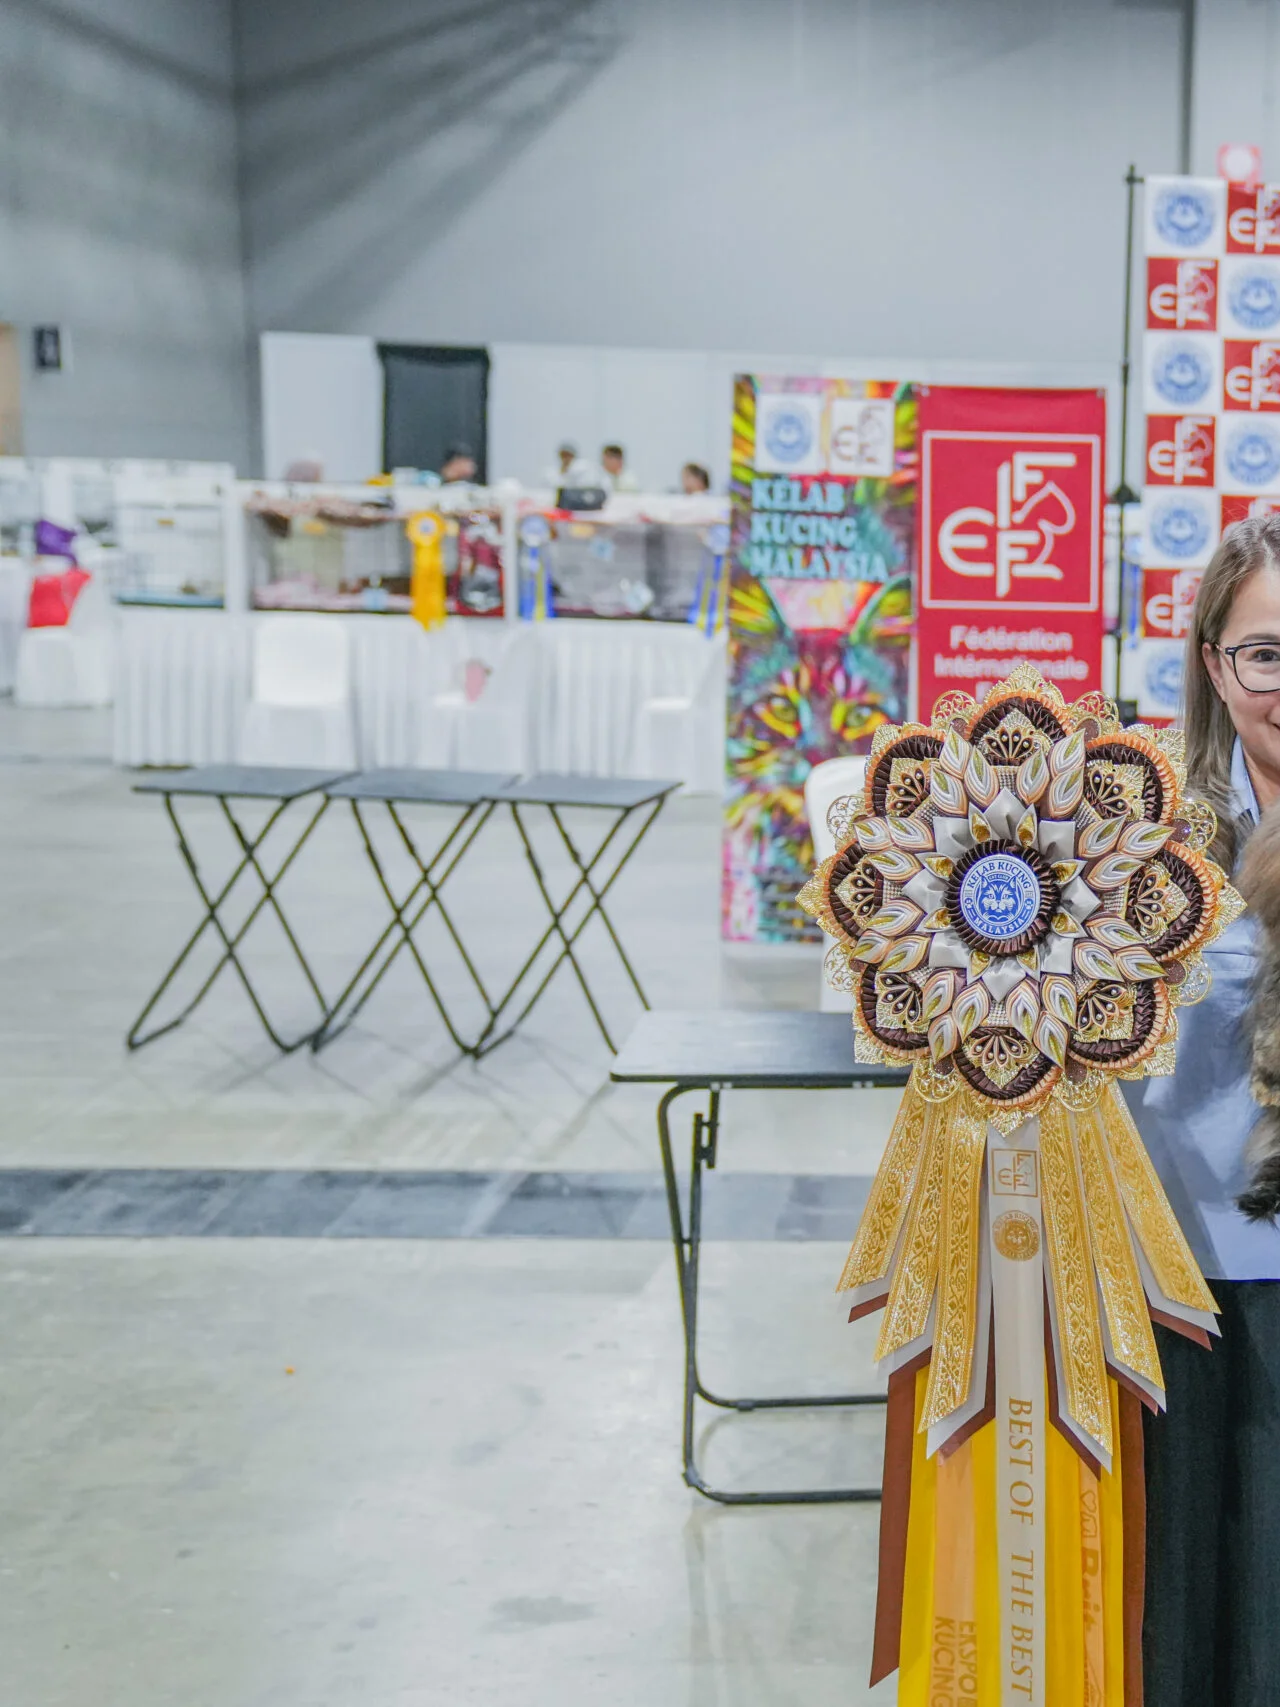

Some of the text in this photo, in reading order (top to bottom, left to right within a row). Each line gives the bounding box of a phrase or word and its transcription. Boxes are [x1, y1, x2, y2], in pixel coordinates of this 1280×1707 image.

[752, 479, 844, 512] KELAB
[750, 512, 858, 547] KUCING
[749, 545, 888, 581] MALAYSIA
[967, 861, 1032, 889] KELAB KUCING
[975, 918, 1025, 936] MALAYSIA
[1009, 1396, 1034, 1702] BEST OF THE BEST
